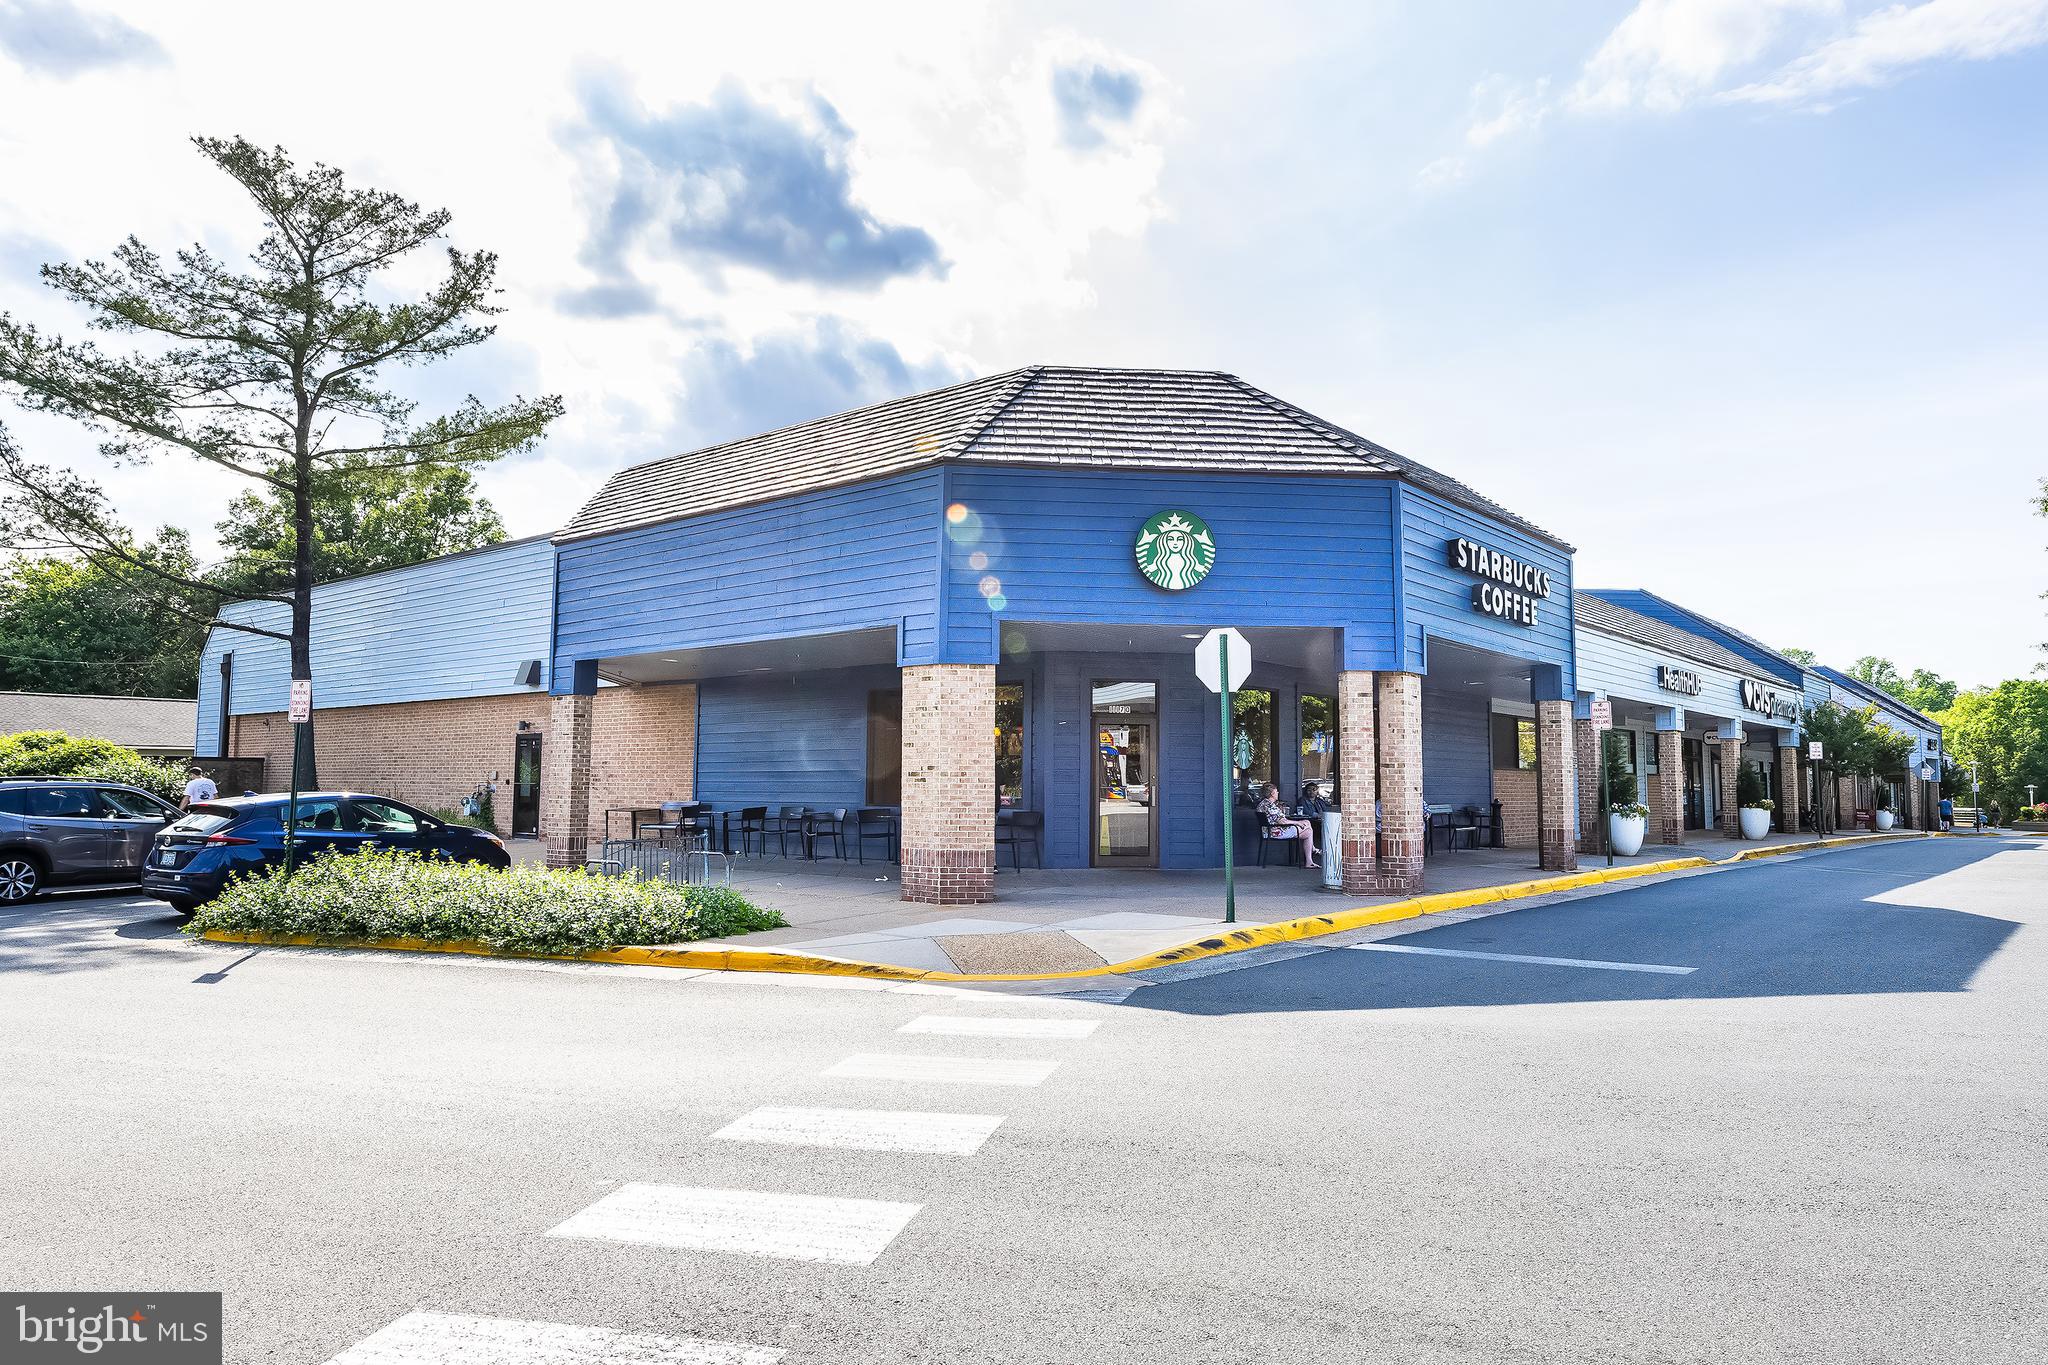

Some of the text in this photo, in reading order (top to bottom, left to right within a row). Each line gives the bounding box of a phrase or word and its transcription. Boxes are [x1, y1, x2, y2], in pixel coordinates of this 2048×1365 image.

[1458, 538, 1551, 598] STARBUCKS
[1481, 582, 1539, 626] COFFEE
[1663, 665, 1703, 695] HealthHUB
[1753, 682, 1771, 714] CVS
